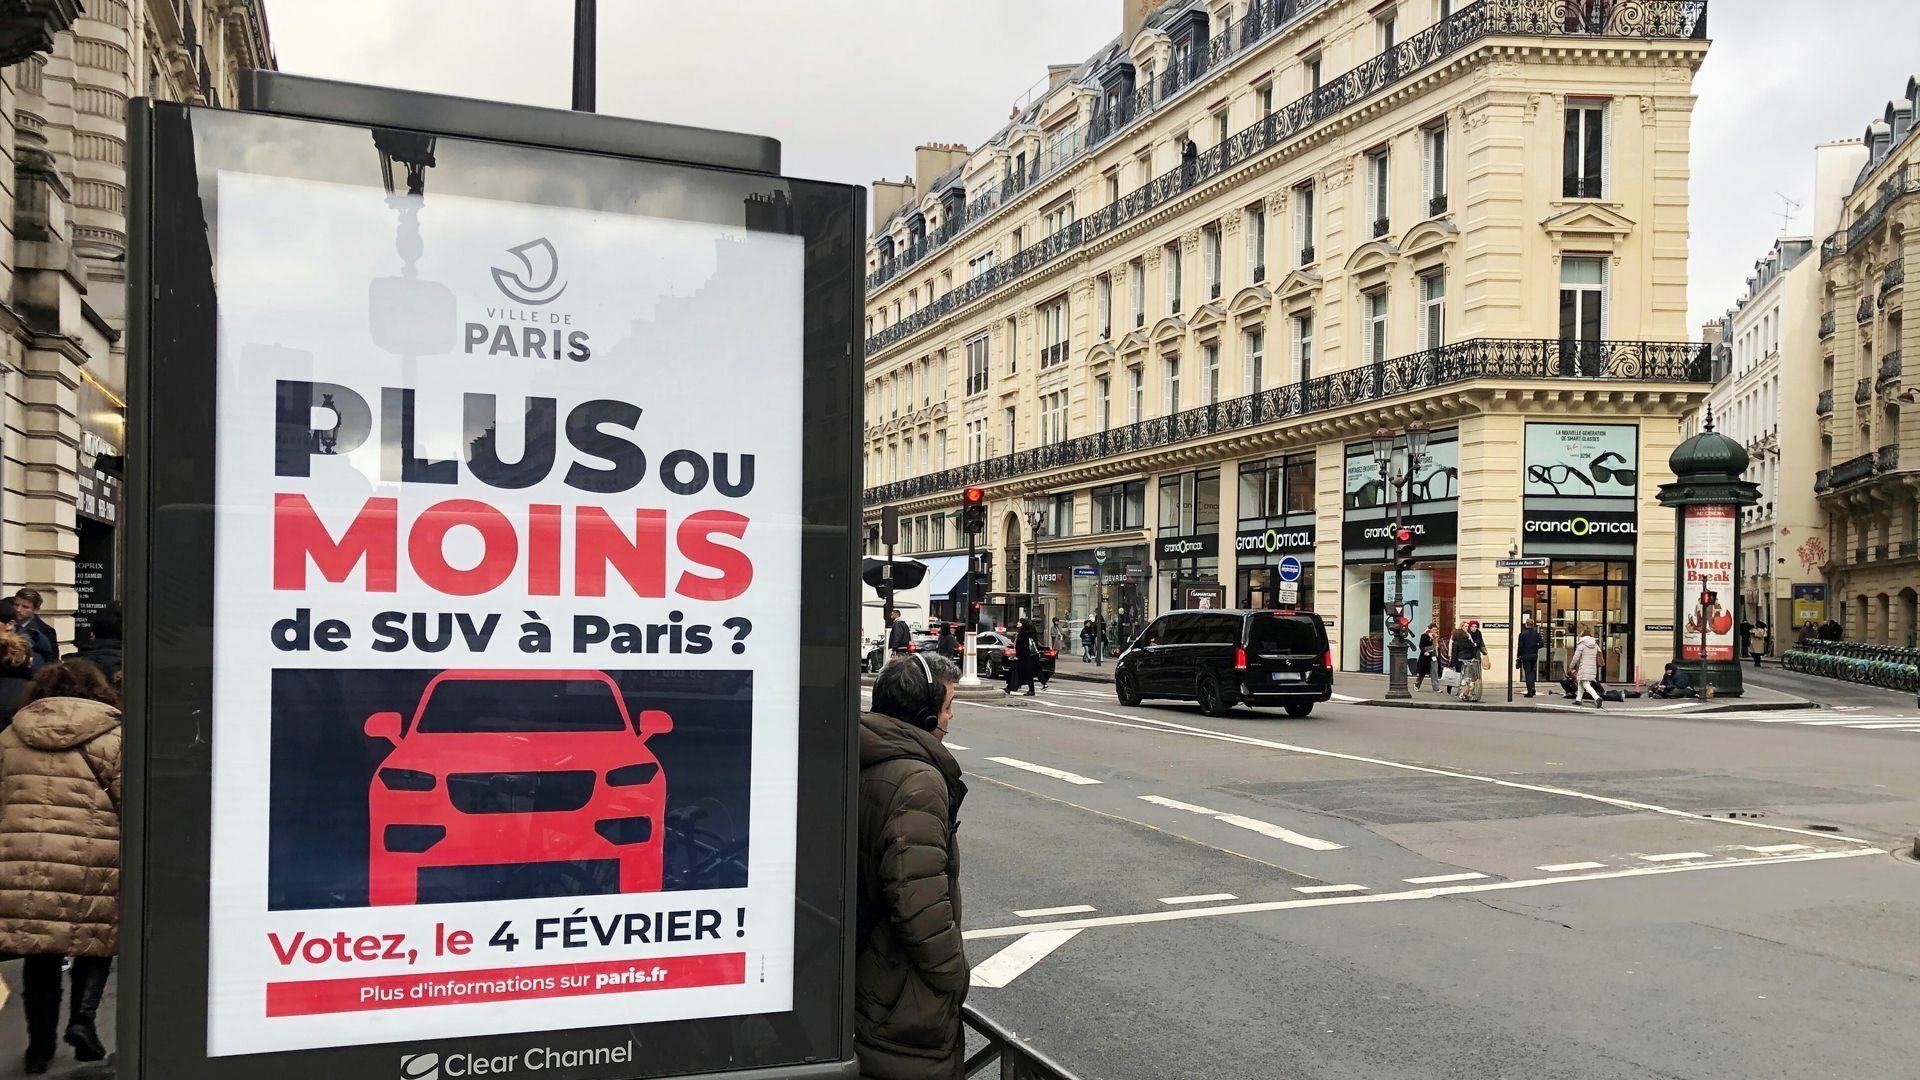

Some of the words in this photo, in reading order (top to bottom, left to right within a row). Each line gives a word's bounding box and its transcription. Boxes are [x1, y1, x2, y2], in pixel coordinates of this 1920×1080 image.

[486, 307, 541, 322] VILLE
[550, 313, 572, 325] DE
[464, 322, 591, 363] PARIS
[274, 379, 647, 494] PLUS
[659, 449, 756, 498] OU
[273, 492, 754, 602] MOINS
[1096, 549, 1106, 557] BUS
[1685, 558, 1733, 569] Winter
[1687, 571, 1730, 582] Break
[270, 608, 352, 652] de
[370, 611, 502, 653] SUV
[518, 610, 552, 654] à
[572, 610, 713, 655] Paris
[722, 616, 753, 655] ?
[268, 932, 418, 966] Votez,
[435, 922, 474, 956] le
[488, 920, 520, 952] 4
[535, 908, 722, 951] FÉVRIER
[736, 907, 746, 938] !
[360, 986, 404, 1002] Plus
[410, 975, 555, 999] d'informations
[560, 975, 591, 988] sur
[595, 967, 668, 989] paris.fr
[445, 1053, 518, 1077] Clear
[524, 1040, 633, 1071] Channel
